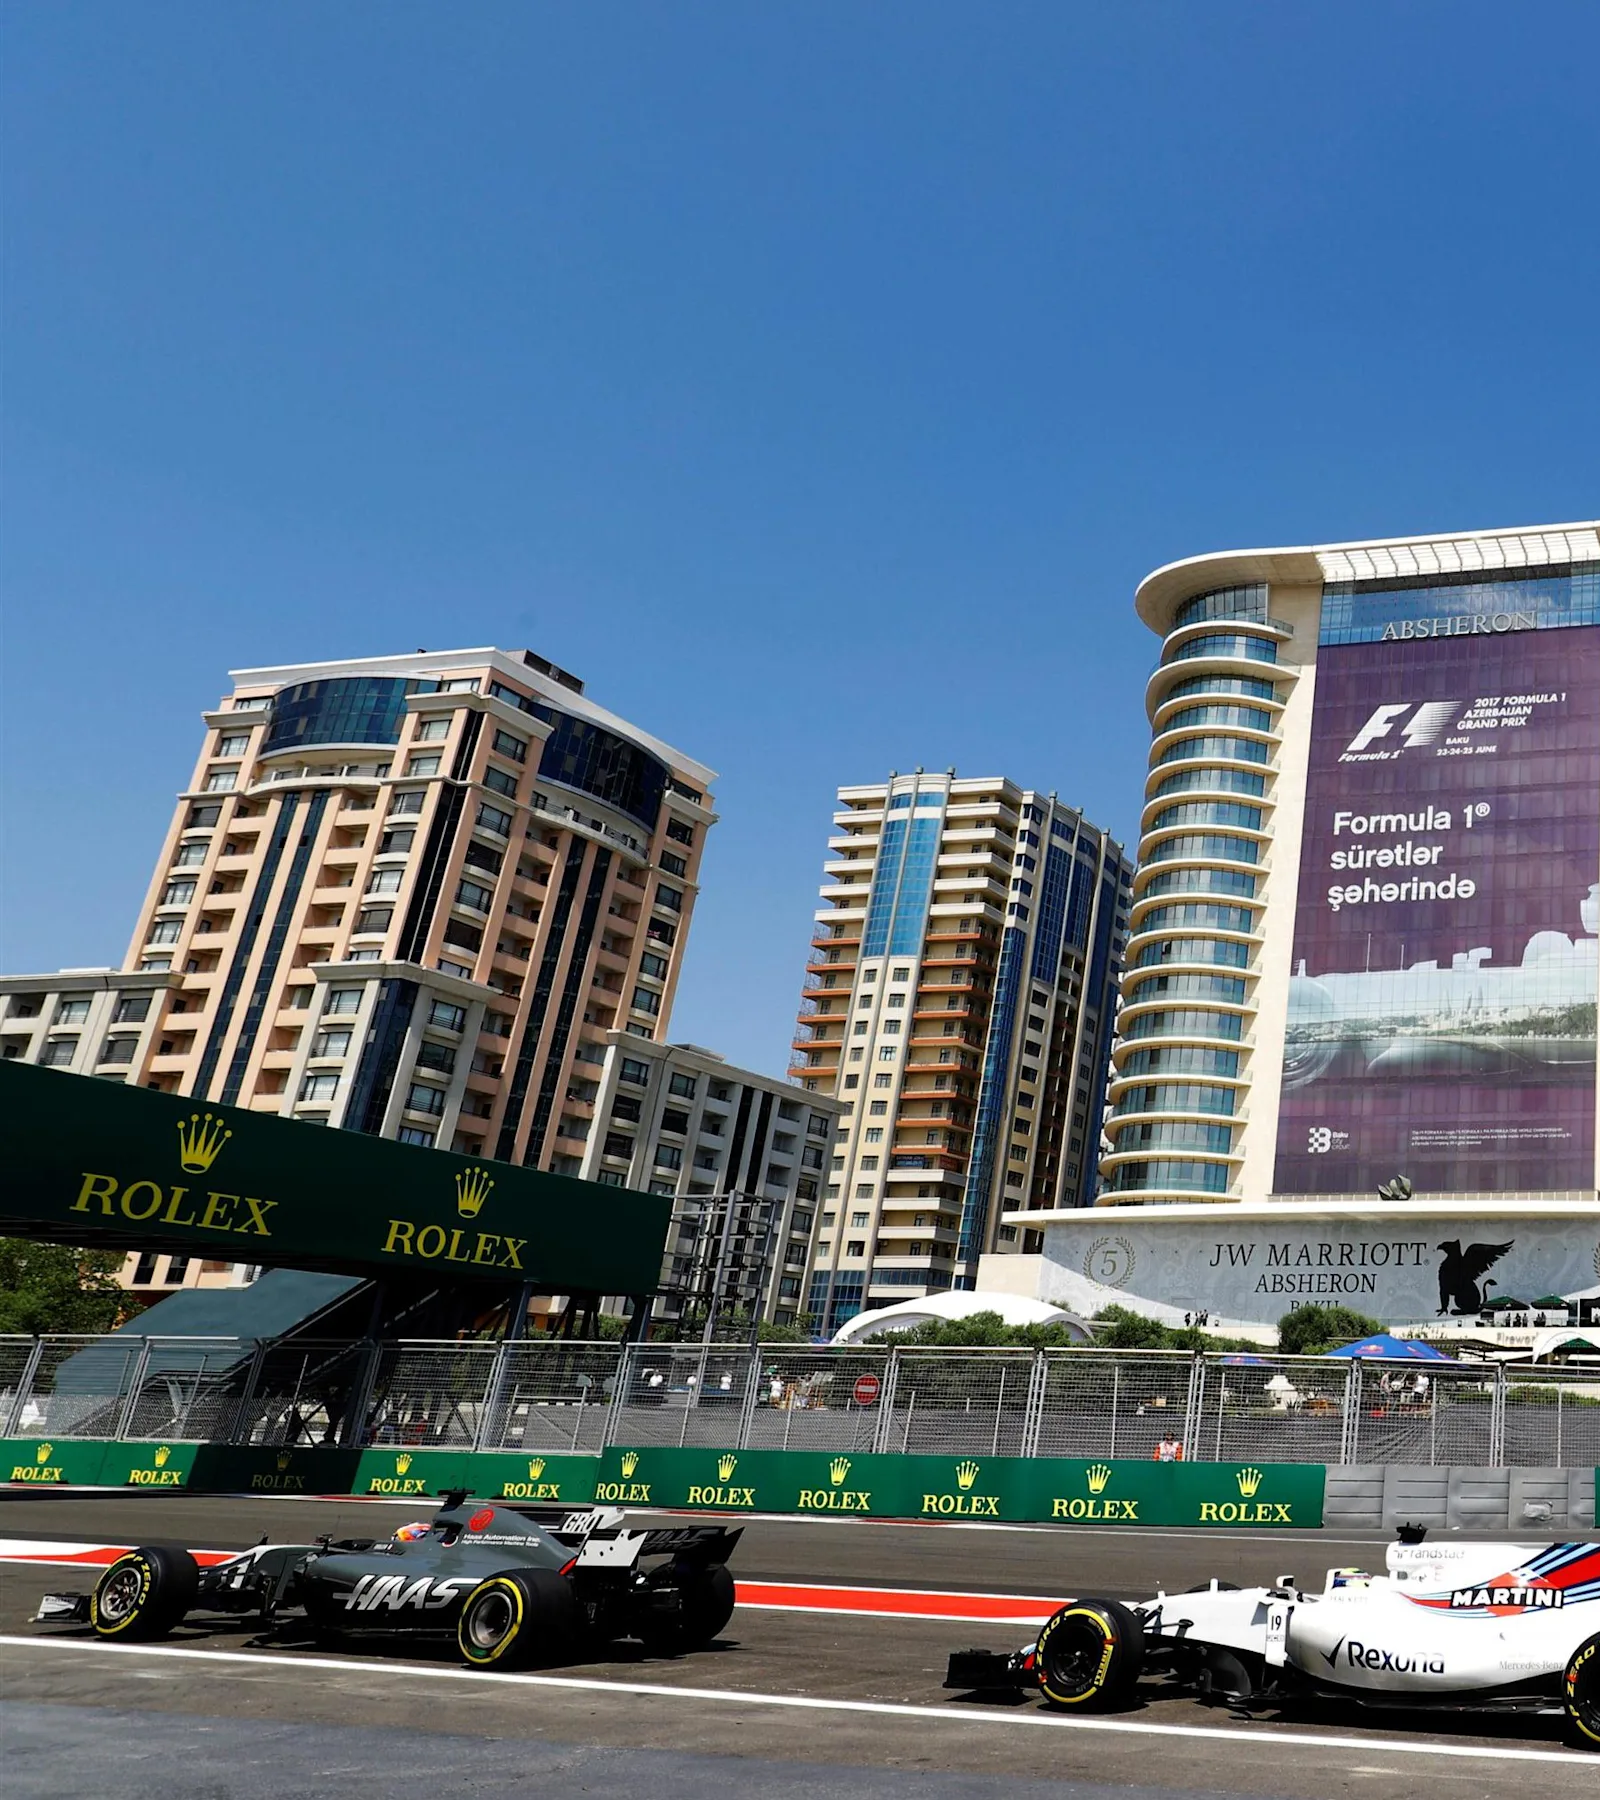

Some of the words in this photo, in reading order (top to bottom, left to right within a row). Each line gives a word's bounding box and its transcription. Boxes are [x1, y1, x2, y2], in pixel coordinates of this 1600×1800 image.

[1381, 611, 1537, 641] ABSHERON
[1474, 698, 1501, 708] 2017
[1503, 693, 1558, 705] FORMULA
[1560, 693, 1566, 702] 1
[1464, 706, 1532, 719] AZERBAIJAN
[1457, 719, 1498, 730] GRAND
[1500, 717, 1527, 727] PRIX
[1445, 737, 1469, 745] BAKU
[1338, 751, 1390, 762] Formula
[1333, 805, 1451, 836] Formula
[1330, 840, 1443, 870] sürətlər
[1328, 874, 1475, 911] şəhərində
[1332, 1131, 1349, 1139] Baku
[69, 1172, 278, 1237] ROLEX
[381, 1220, 527, 1270] ROLEX
[1101, 1250, 1118, 1277] 5
[1209, 1243, 1257, 1268] JW
[1254, 1273, 1378, 1293] ABSHERON
[1496, 1331, 1538, 1344] Firewor
[10, 1466, 63, 1482] ROLEX
[128, 1469, 184, 1485] ROLEX
[251, 1474, 305, 1489] ROLEX
[370, 1478, 426, 1493] ROLEX
[502, 1483, 560, 1499] ROLEX
[595, 1483, 651, 1502] ROLEX
[688, 1486, 755, 1507] ROLEX
[798, 1489, 871, 1511] ROLEX
[922, 1494, 999, 1516] ROLEX
[1050, 1498, 1138, 1520] ROLEX
[1199, 1502, 1292, 1523] ROLEX
[483, 1533, 526, 1541] Automation
[137, 1562, 151, 1605] ZERO
[332, 1574, 484, 1611] HAAS
[1451, 1588, 1563, 1608] MARTINI
[1270, 1615, 1282, 1631] 19
[1036, 1616, 1061, 1666] ZERO
